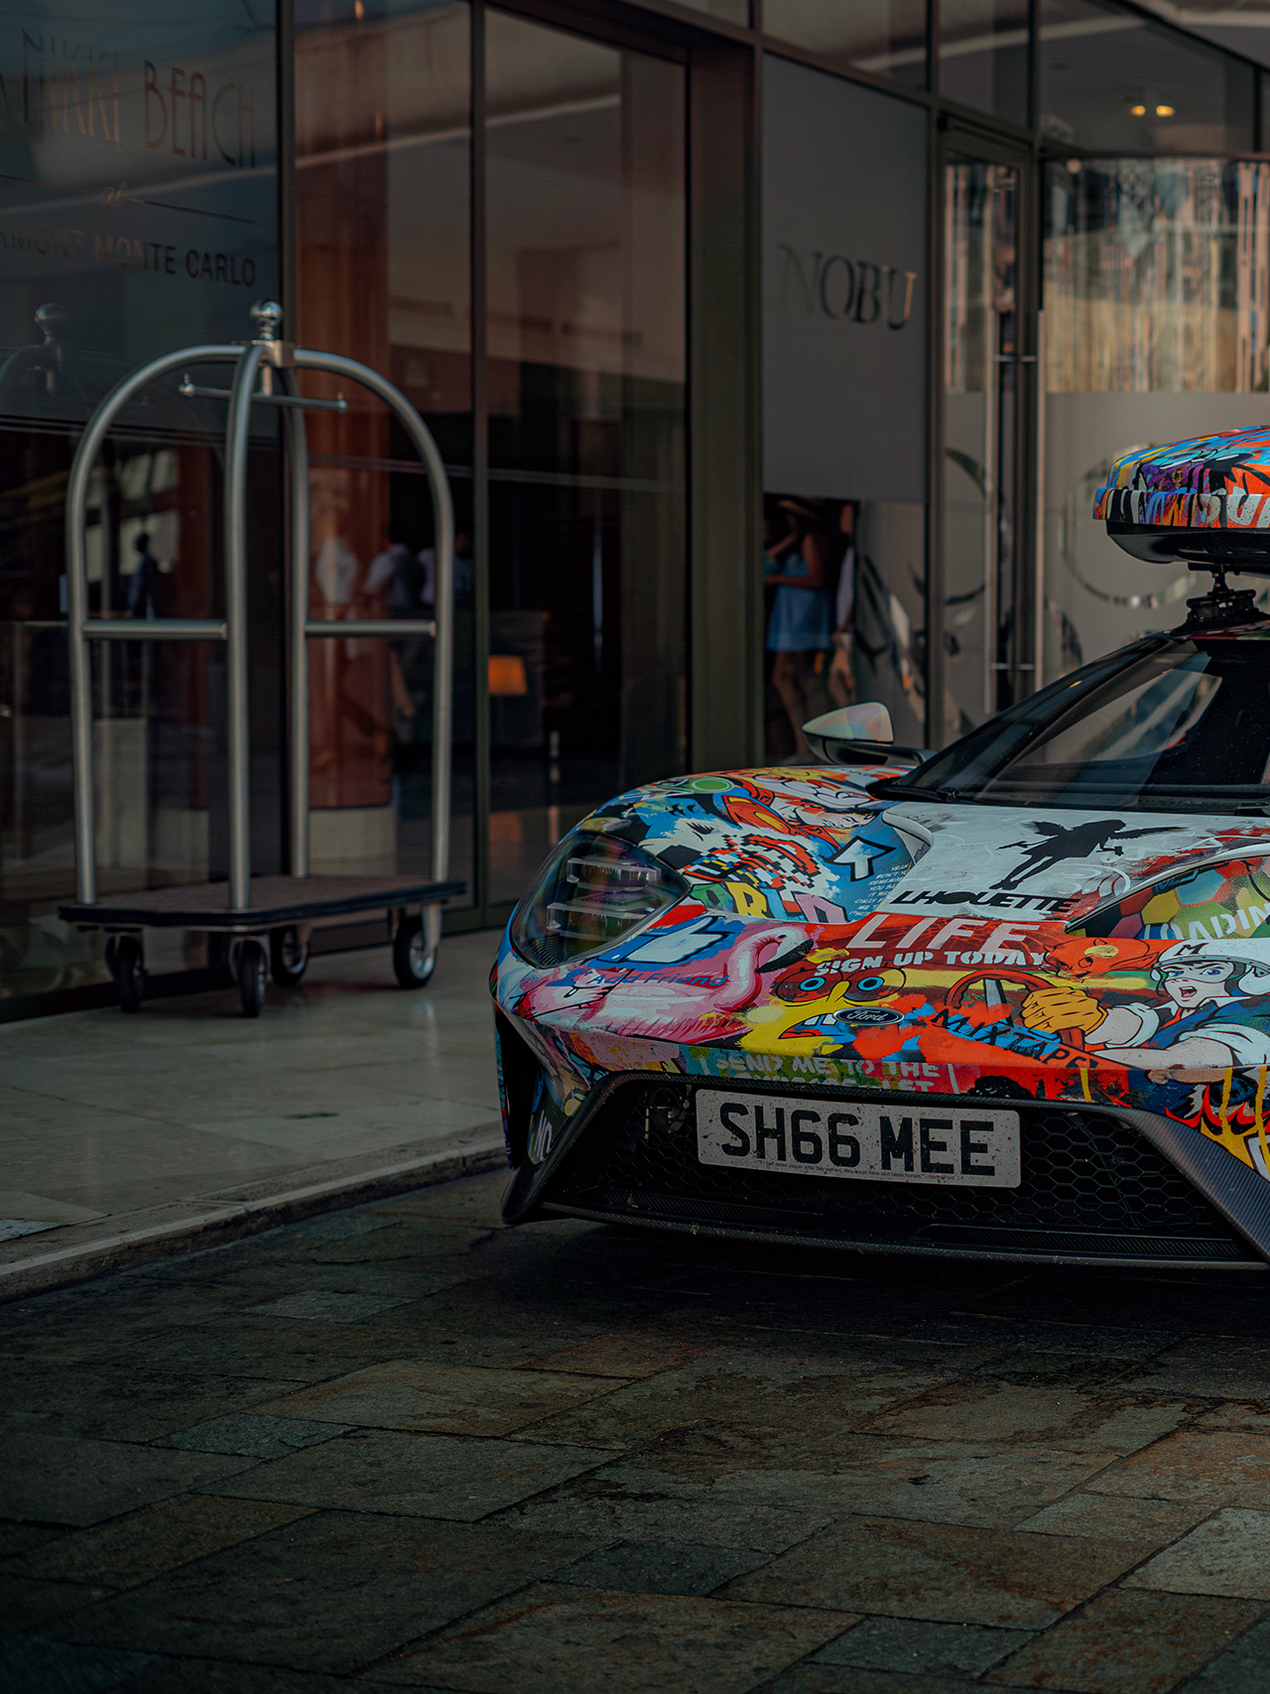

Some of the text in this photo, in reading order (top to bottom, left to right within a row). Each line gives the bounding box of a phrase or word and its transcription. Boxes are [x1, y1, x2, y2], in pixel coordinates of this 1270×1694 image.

[23, 29, 256, 168] NIKKI BEACH
[94, 233, 177, 275] MONTE
[185, 248, 257, 288] CARLO
[776, 242, 918, 331] NOBU
[847, 914, 1041, 956] LIFE
[586, 973, 730, 987] Add Friend
[814, 950, 1048, 976] SIGN UP TODAY
[844, 1008, 892, 1024] Ford
[791, 1056, 833, 1075] ME
[882, 1061, 940, 1078] THE
[719, 1102, 995, 1176] SH66 MEE
